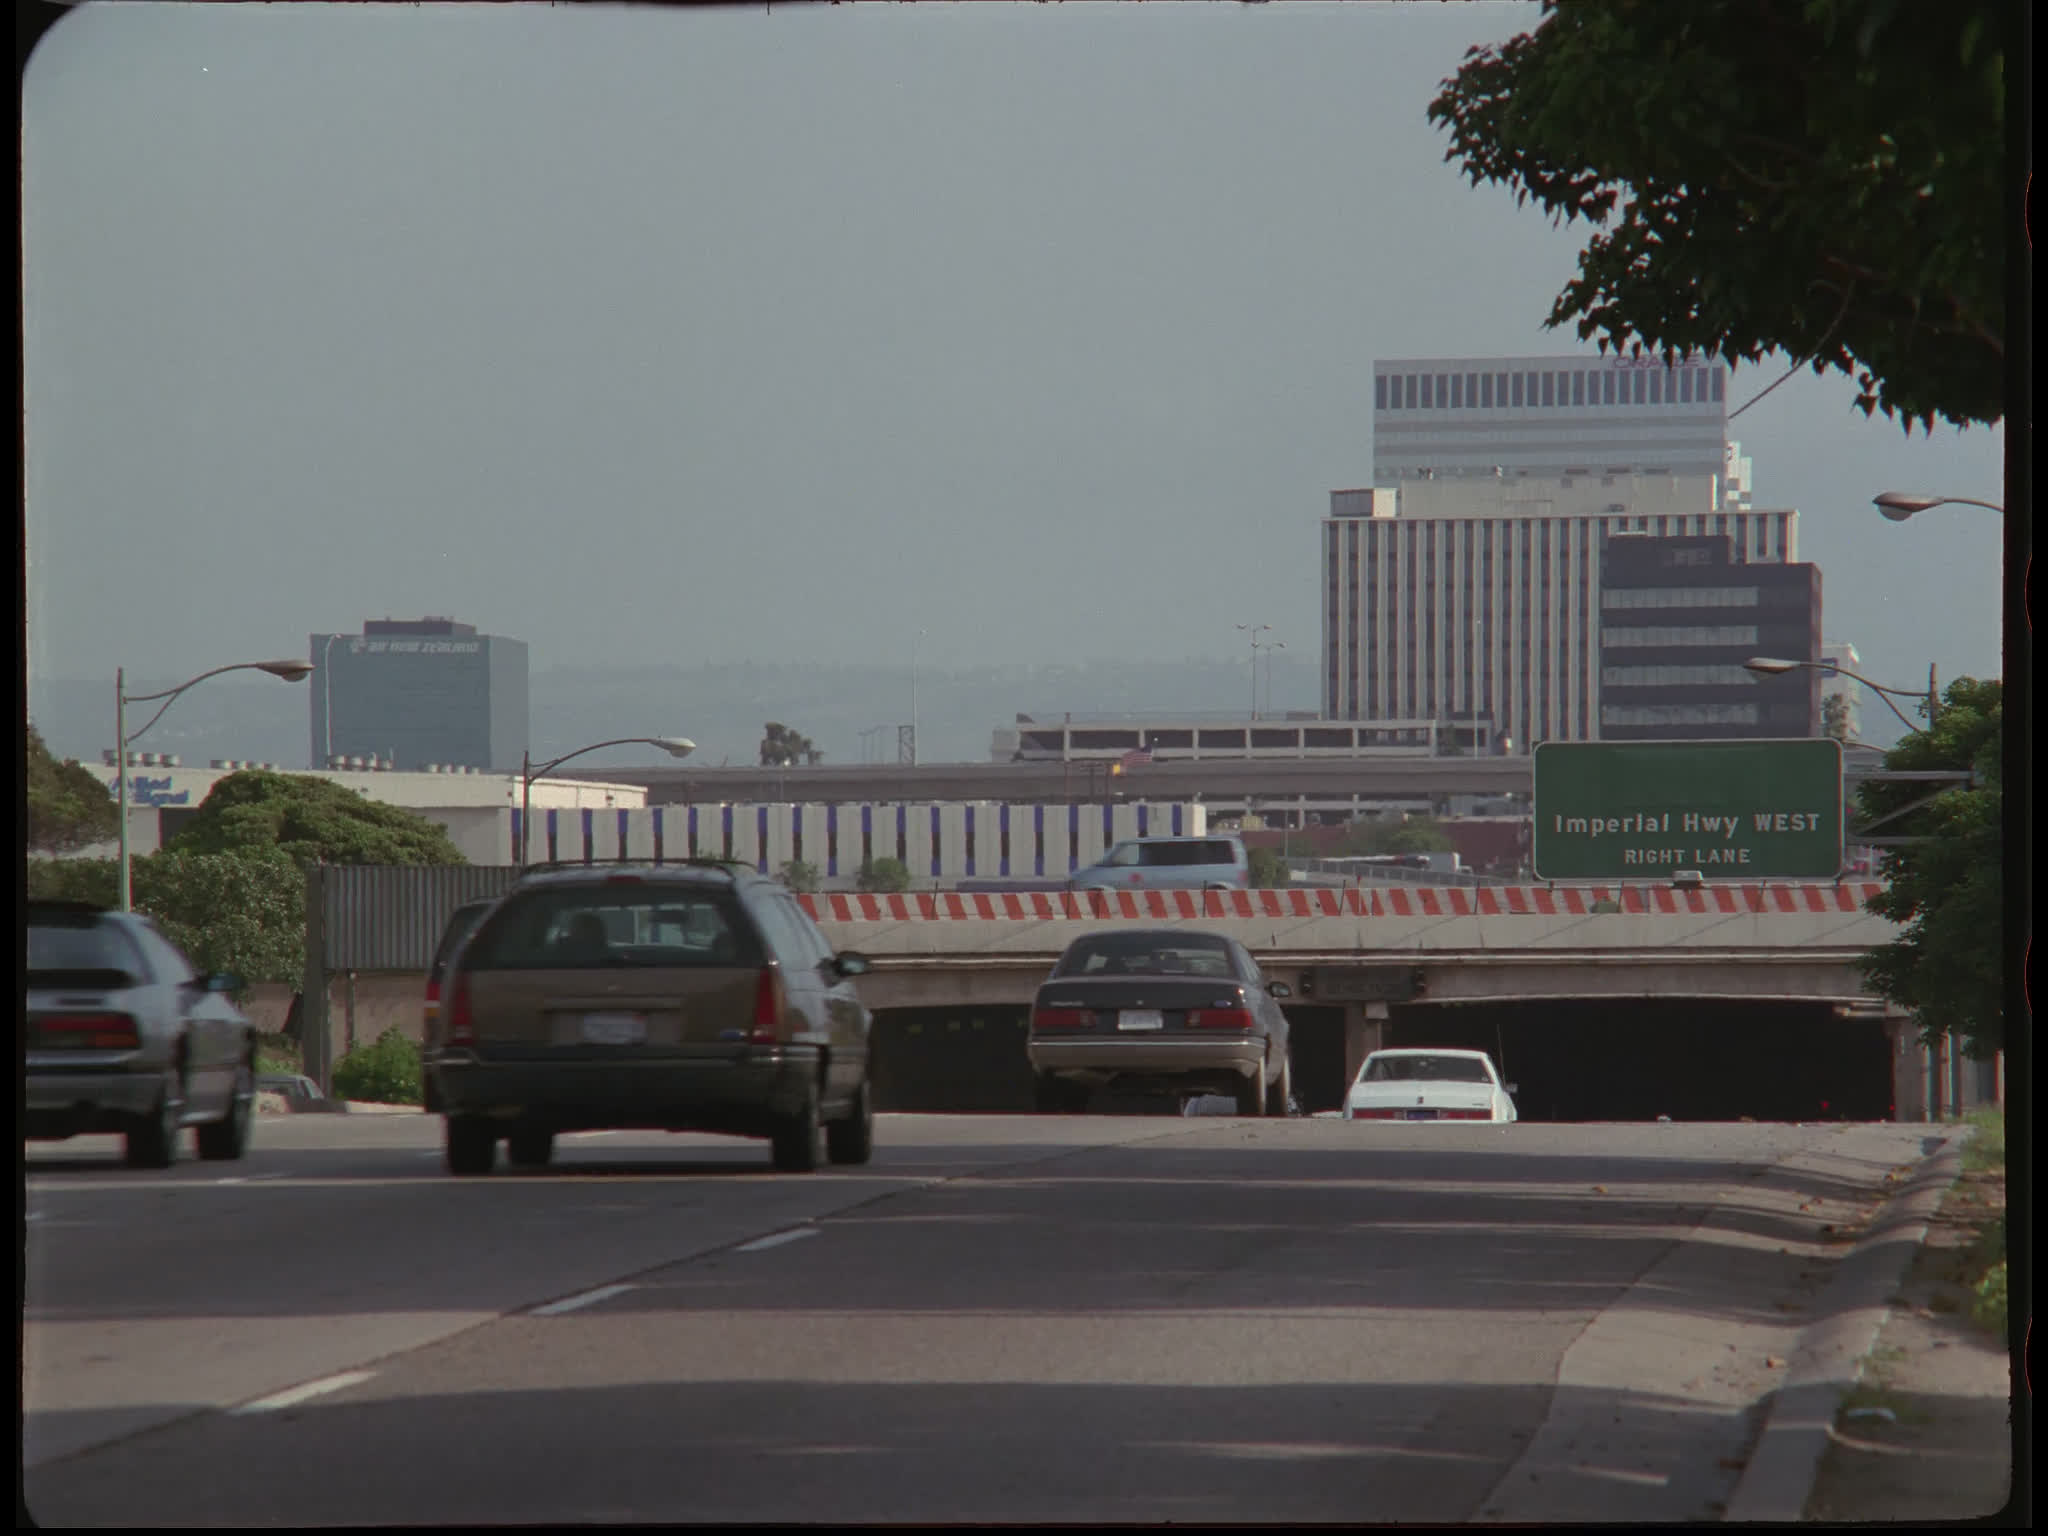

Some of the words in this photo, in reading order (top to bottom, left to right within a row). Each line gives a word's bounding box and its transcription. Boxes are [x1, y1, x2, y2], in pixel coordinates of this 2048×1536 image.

[1613, 352, 1699, 368] ORALE
[1554, 813, 1670, 838] Imperial
[1682, 814, 1740, 839] Hwy
[1753, 813, 1820, 832] WEST
[1624, 848, 1685, 864] RIGHT
[1695, 848, 1752, 864] LANE
